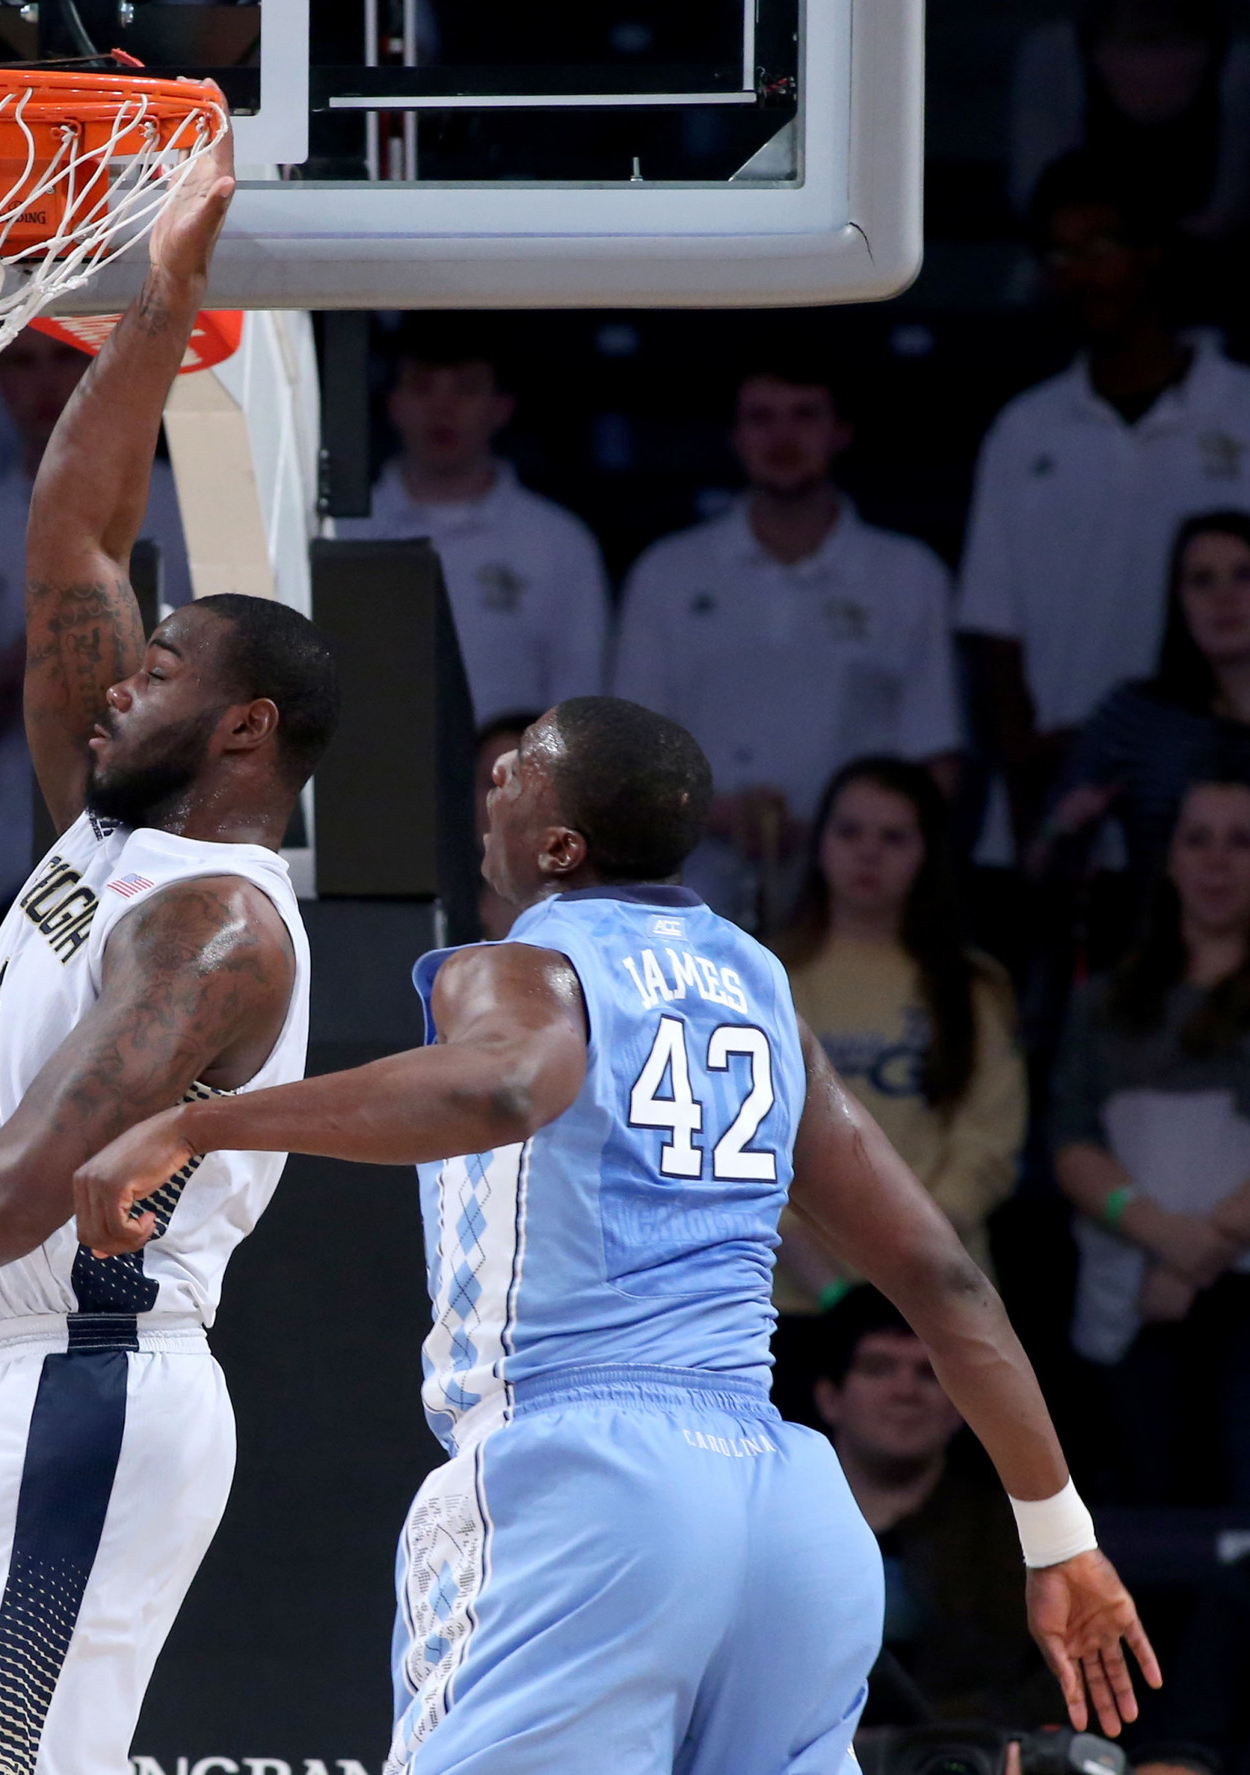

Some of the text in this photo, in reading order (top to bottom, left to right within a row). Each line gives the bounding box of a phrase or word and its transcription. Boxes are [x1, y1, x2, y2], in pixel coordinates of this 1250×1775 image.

[653, 918, 682, 936] ACC
[622, 947, 748, 1015] JAMES
[627, 1013, 778, 1184] 42
[682, 1429, 777, 1457] CAROLINA
